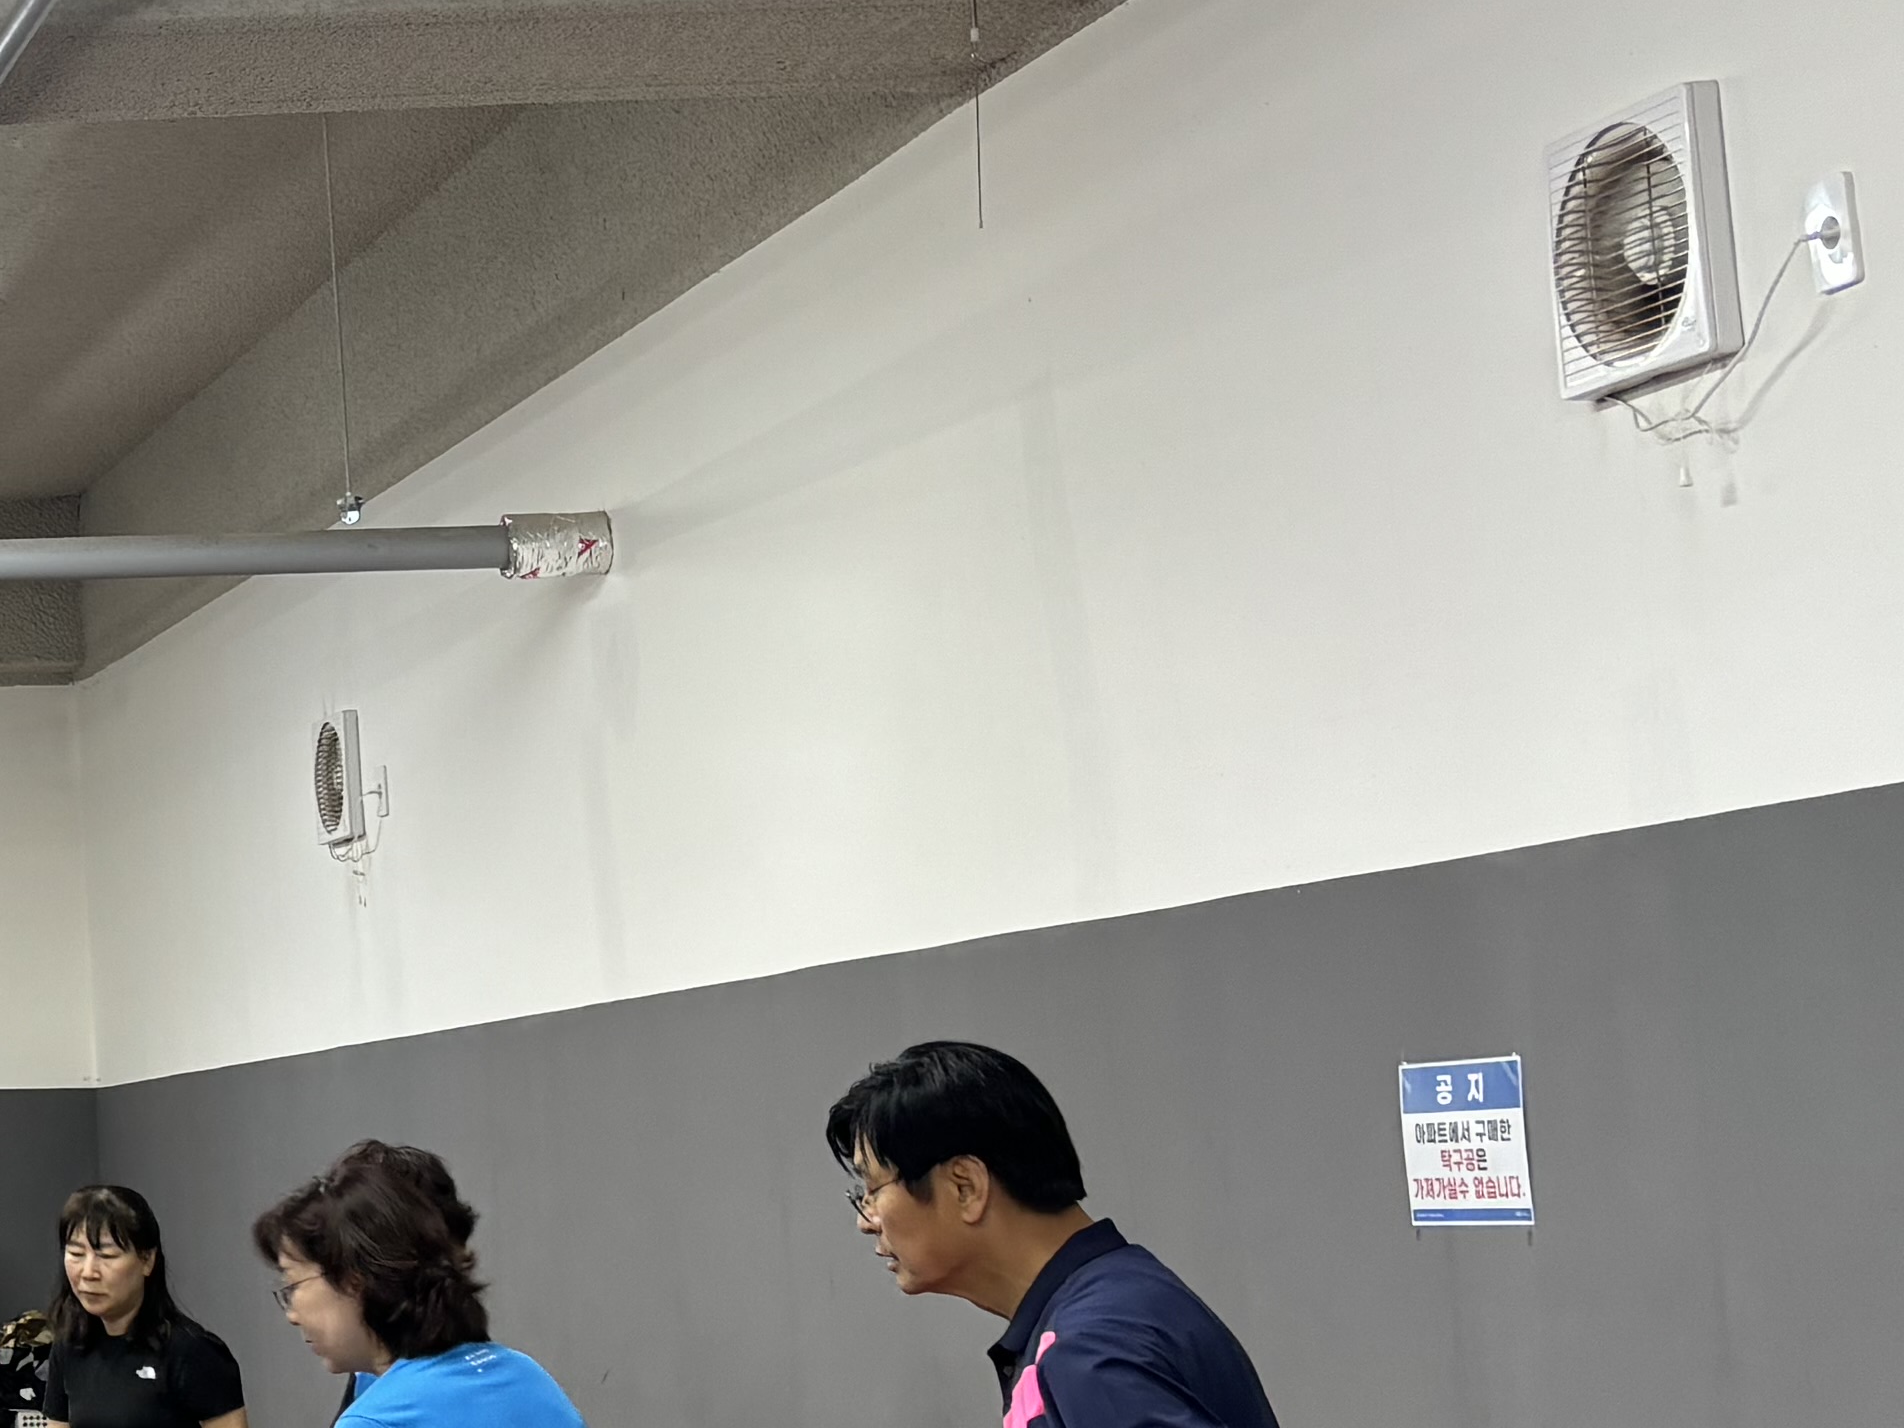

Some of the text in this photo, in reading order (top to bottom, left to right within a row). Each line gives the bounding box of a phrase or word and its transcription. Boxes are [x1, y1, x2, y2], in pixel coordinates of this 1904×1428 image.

[1415, 1121, 1471, 1144] 아파트에서
[1440, 1147, 1488, 1172] 탁구공은
[1473, 1175, 1526, 1200] 없습니다.
